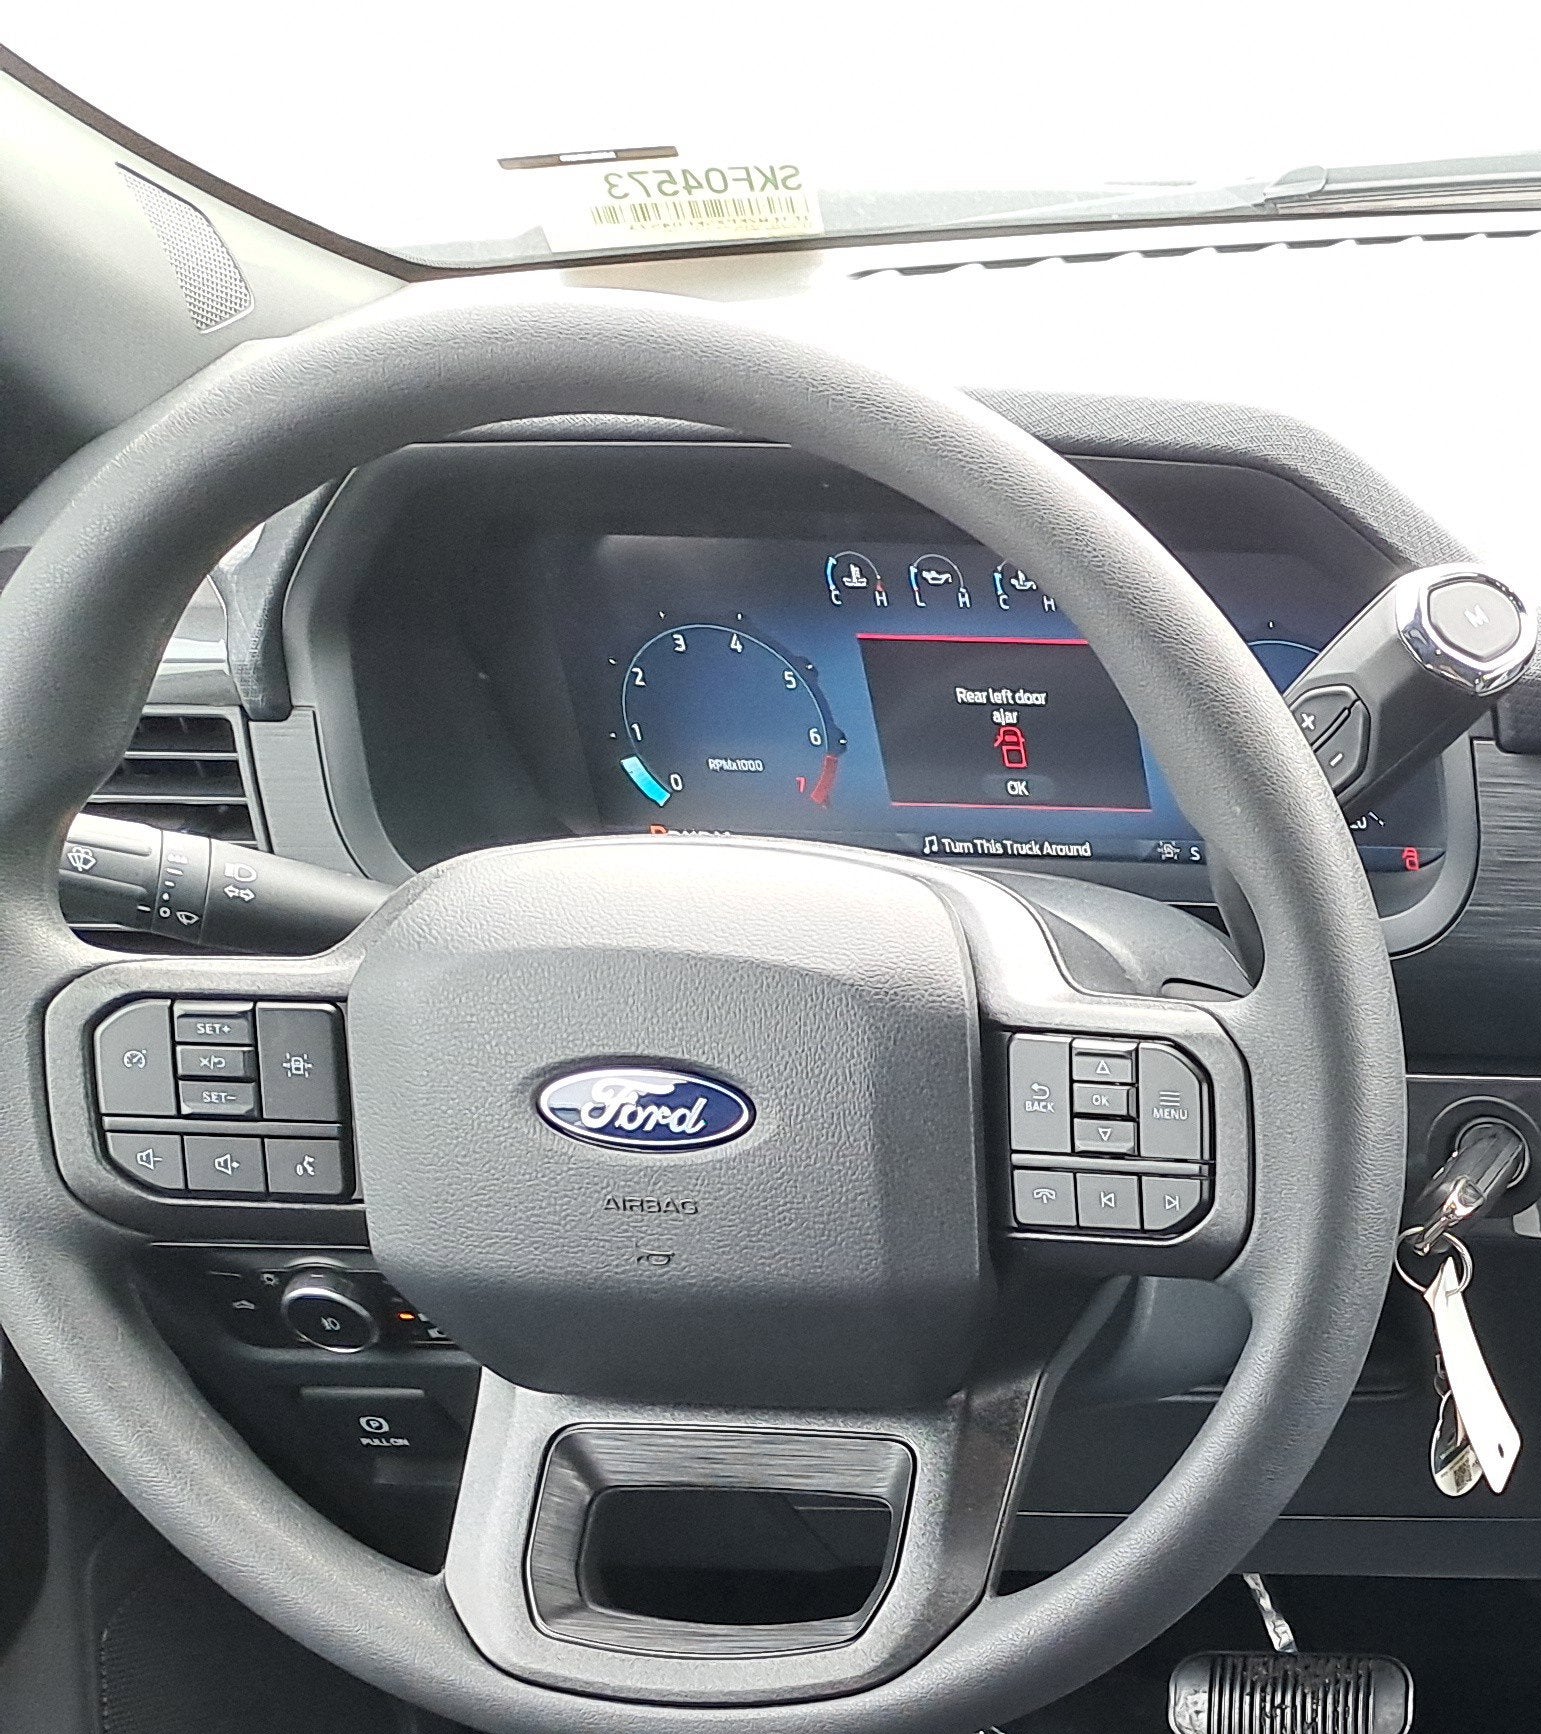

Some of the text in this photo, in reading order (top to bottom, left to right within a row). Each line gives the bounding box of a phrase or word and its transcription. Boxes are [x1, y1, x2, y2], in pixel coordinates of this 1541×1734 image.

[875, 591, 888, 607] H
[958, 592, 971, 608] H
[673, 634, 687, 652] 3
[730, 633, 743, 653] 4
[632, 667, 647, 687] 2
[783, 671, 797, 689] 5
[956, 688, 1047, 705] Rear left door
[992, 708, 1018, 726] ajar
[632, 723, 642, 740] 1
[808, 728, 822, 746] 6
[670, 773, 683, 791] 0
[1007, 780, 1030, 796] OK
[941, 838, 1092, 858] Turn This Truck Around
[580, 1077, 709, 1134] Ford
[1024, 1100, 1055, 1114] BACK
[1091, 1093, 1110, 1108] OK
[1152, 1107, 1189, 1121] MENU
[603, 1193, 700, 1216] AIRBAG
